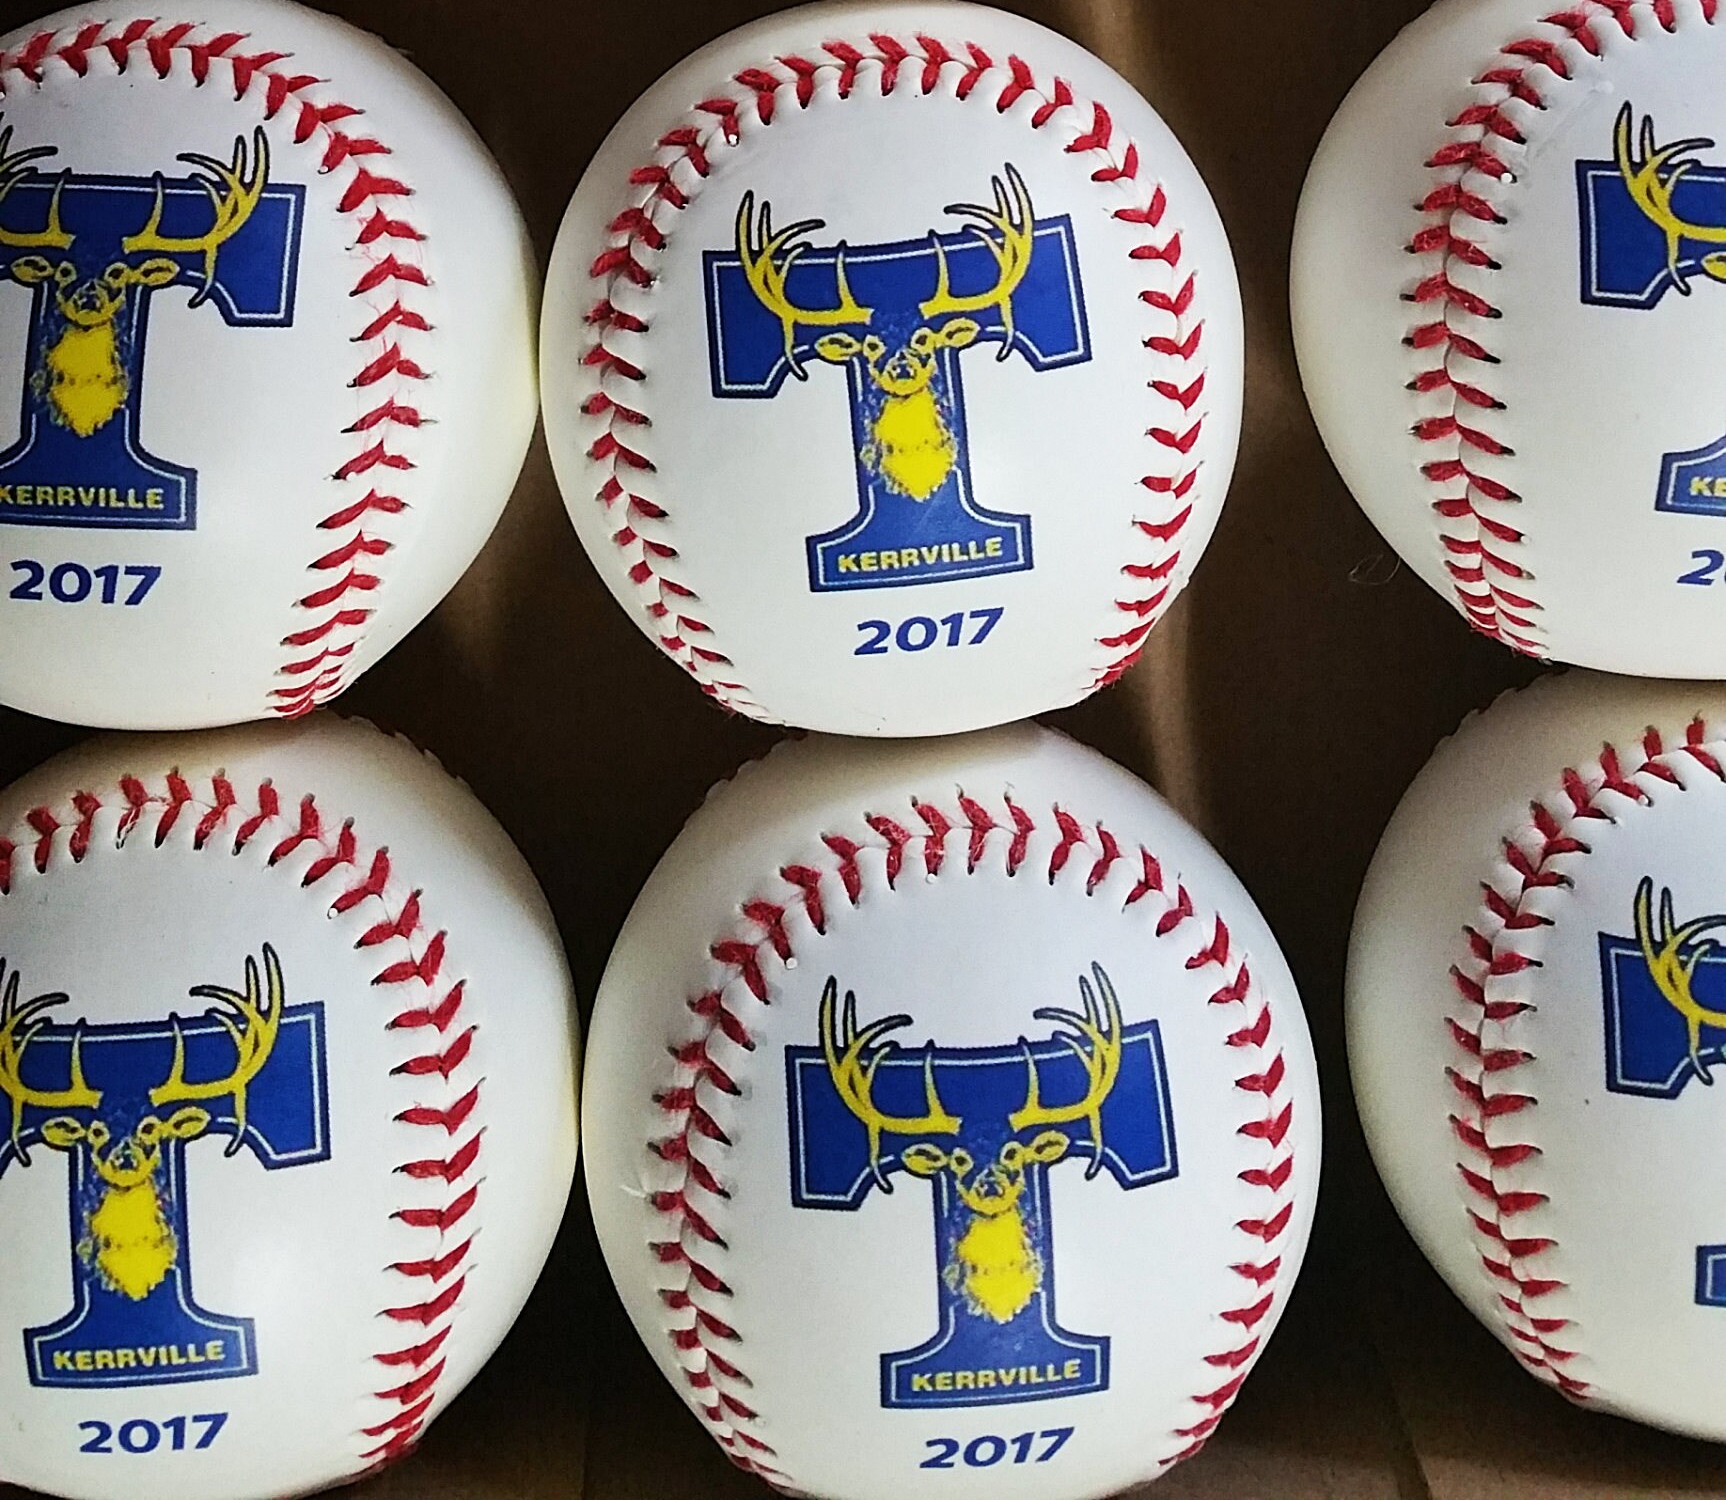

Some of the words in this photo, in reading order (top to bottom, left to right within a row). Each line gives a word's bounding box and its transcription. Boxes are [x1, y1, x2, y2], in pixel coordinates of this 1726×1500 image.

[837, 537, 1003, 573] KERRVILLE
[9, 559, 162, 606] 2017
[854, 607, 1004, 656] 2017
[53, 1339, 226, 1371] KERRVILLE
[911, 1359, 1082, 1392] KERRVILLE
[78, 1412, 228, 1454] 2017
[919, 1426, 1075, 1469] 2017
